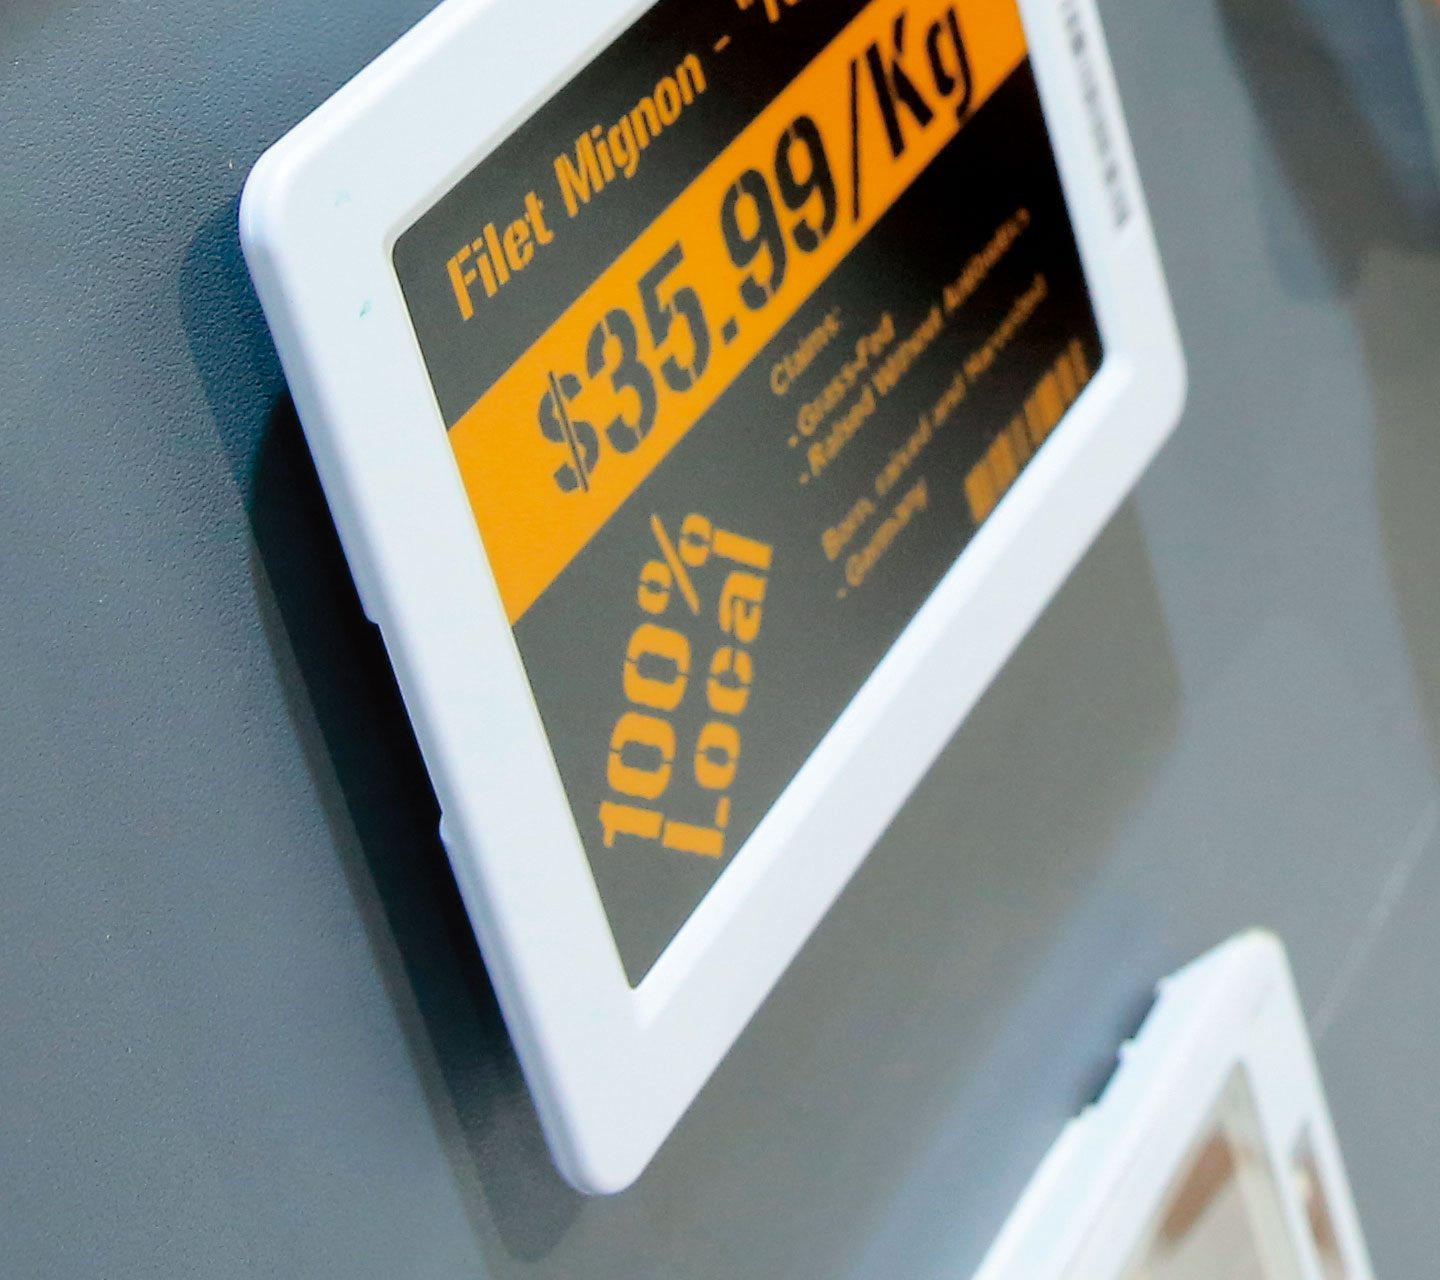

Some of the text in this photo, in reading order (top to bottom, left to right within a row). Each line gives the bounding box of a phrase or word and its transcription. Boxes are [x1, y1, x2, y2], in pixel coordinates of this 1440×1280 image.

[446, 190, 555, 322] Filet
[553, 52, 708, 219] Mignon
[537, 0, 978, 494] $35.99/Kg
[598, 512, 717, 849] 100%
[661, 527, 773, 860] Local
